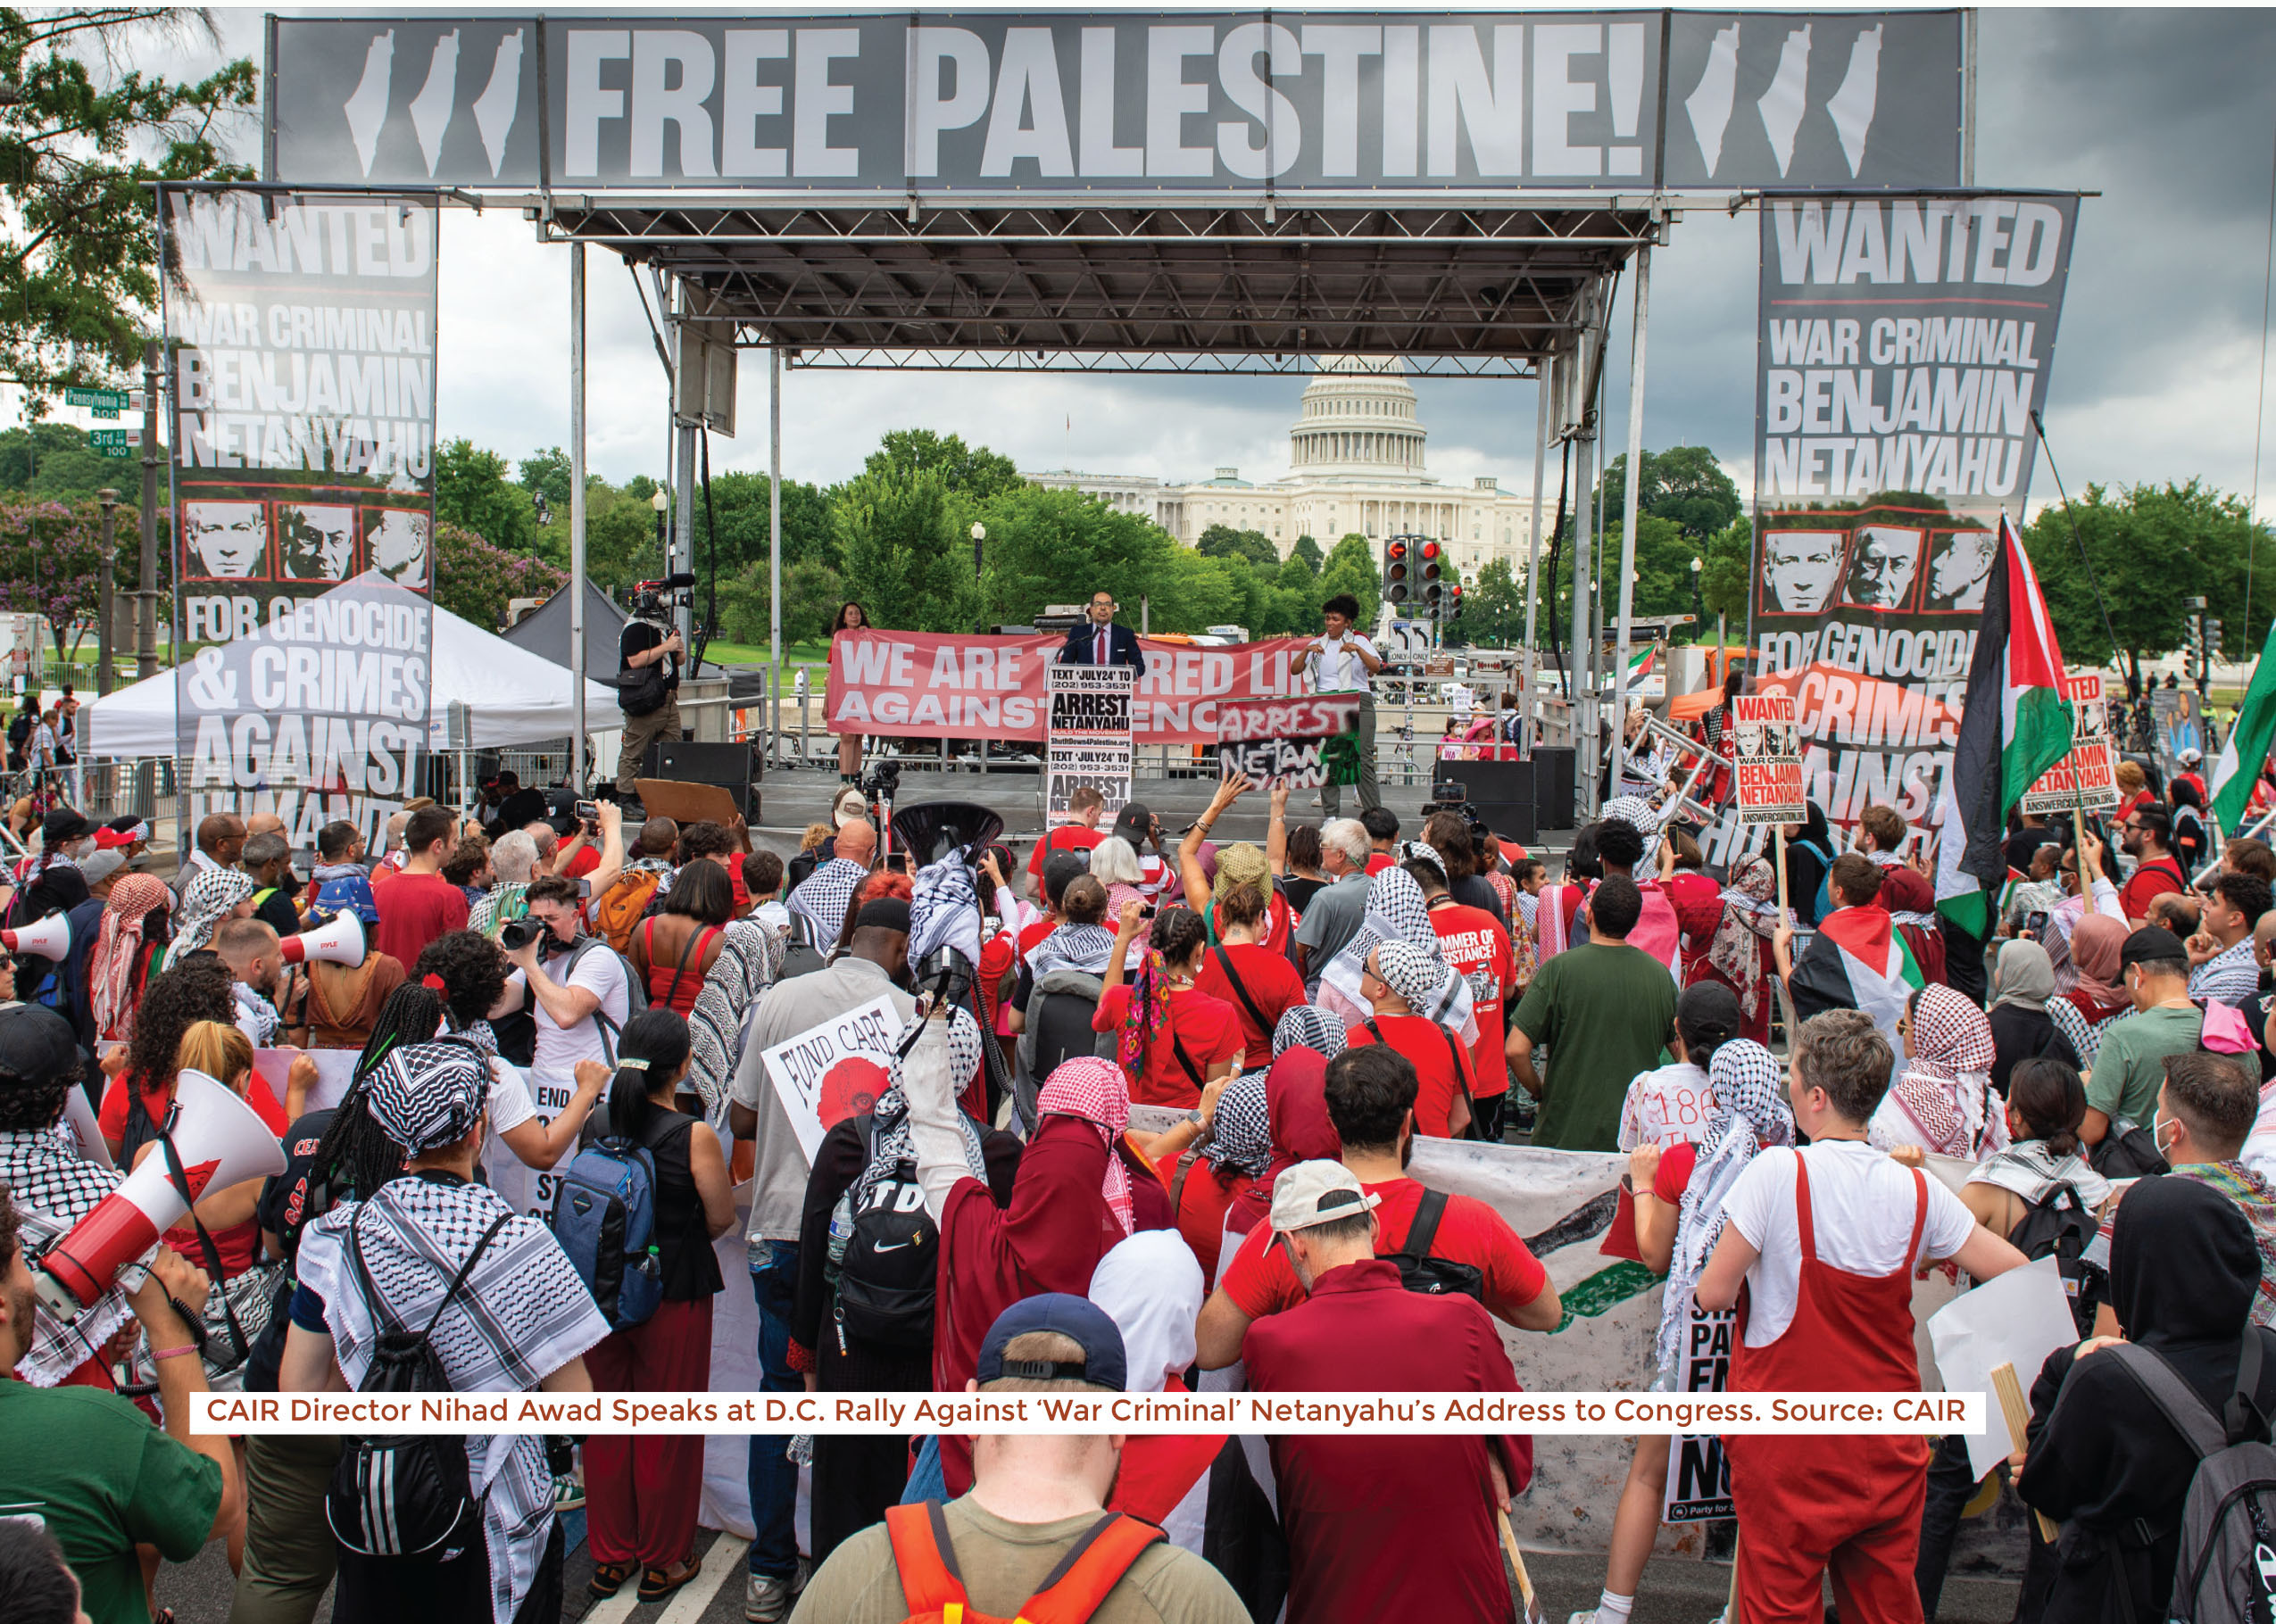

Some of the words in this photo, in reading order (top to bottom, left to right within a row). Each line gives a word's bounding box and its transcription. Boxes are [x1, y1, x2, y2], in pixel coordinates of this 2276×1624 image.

[565, 27, 860, 178] FREE
[905, 22, 1646, 178] PALESTINE!
[169, 192, 430, 278] WANTED
[1773, 199, 2063, 287] WANTED
[178, 302, 261, 347] WAR
[269, 303, 432, 354] CRIMINAL
[1769, 319, 1860, 365] WAR
[1869, 316, 2039, 369] CRIMINAL
[68, 389, 117, 407] Pennsylvania
[178, 349, 431, 419] BENJAMIN
[1766, 366, 2035, 436] BENJAMIN
[93, 431, 112, 445] 3rd
[106, 446, 127, 456] 100
[179, 412, 430, 479] NETANYAHU
[1764, 433, 2024, 497] NETANYAHU
[187, 595, 261, 642] FOR
[269, 595, 428, 654] GENOCIDE
[841, 641, 915, 687] WE
[928, 645, 1023, 691] ARE
[1139, 650, 1234, 696] RED
[1250, 650, 1307, 695] LI
[1756, 630, 1820, 679] FOR
[188, 645, 239, 710] &
[251, 645, 426, 723] CRIMES
[1051, 669, 1074, 679] TEXT
[1118, 671, 1131, 681] TO
[1051, 681, 1078, 689] (202)
[2066, 676, 2099, 701] TED
[1052, 692, 1131, 717] ARREST
[1736, 698, 1796, 721] WANTED
[1796, 671, 1968, 749] CRIMES
[1051, 716, 1130, 730] NETANYAHU
[1217, 700, 1359, 742] ARREST
[190, 713, 424, 800] AGAINST
[1051, 751, 1073, 762] TEXT
[1117, 753, 1129, 763] TO
[1219, 737, 1327, 775] NETAN
[2072, 737, 2106, 747] IMINAL
[1051, 763, 1077, 771] (202)
[1079, 764, 1129, 772] 953-3531
[1739, 764, 1803, 786] BENJAMIN
[1740, 785, 1804, 805] NETANYAHU
[1800, 744, 1956, 826] AINST
[1051, 797, 1128, 813] NEAHU
[1439, 931, 1480, 953] MMER
[1480, 929, 1495, 945] OF
[1442, 944, 1493, 965] SISTANCE
[779, 1035, 835, 1109] FUND
[838, 1008, 894, 1057] CARE
[537, 1086, 570, 1108] END
[1690, 1505, 1713, 1514] Party
[1715, 1504, 1728, 1512] for
